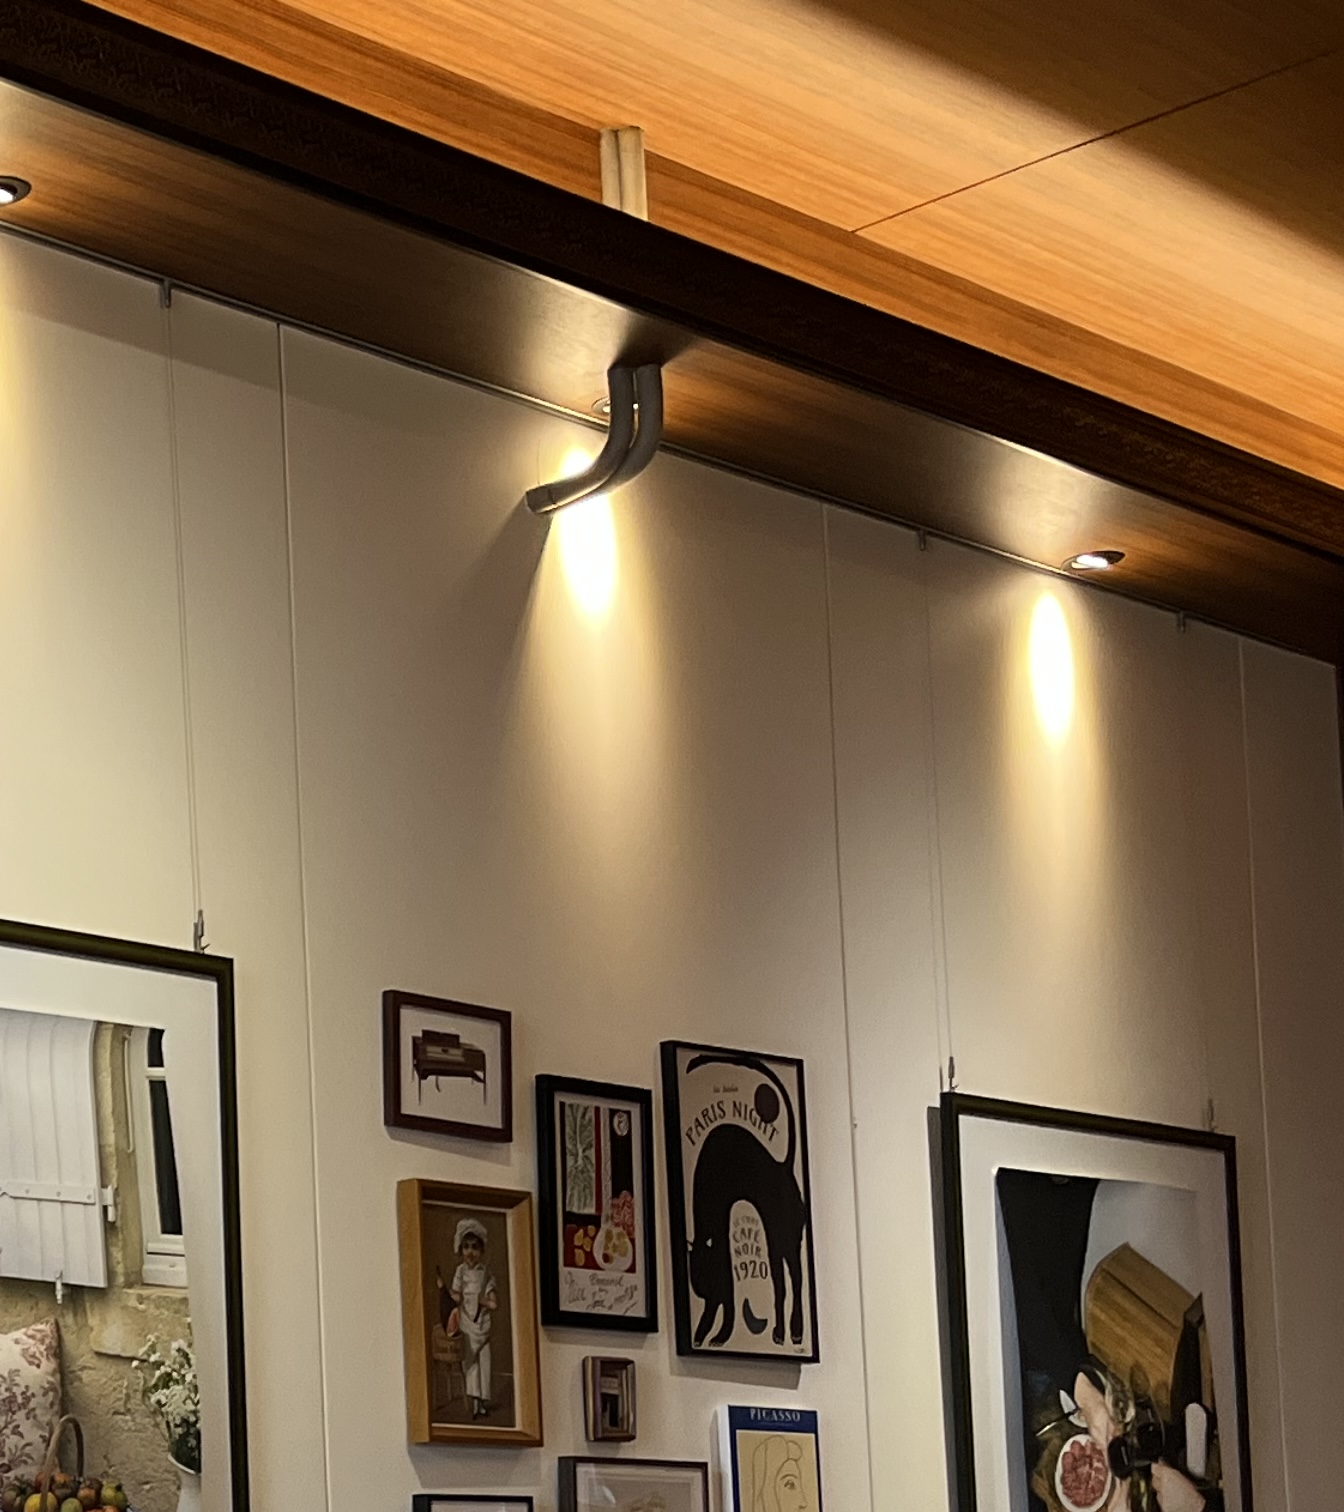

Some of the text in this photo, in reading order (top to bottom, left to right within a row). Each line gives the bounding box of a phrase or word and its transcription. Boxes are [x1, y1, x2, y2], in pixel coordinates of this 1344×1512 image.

[685, 1100, 727, 1146] PARIS
[734, 1260, 768, 1282] 1920
[750, 1408, 801, 1422] PICASSO
